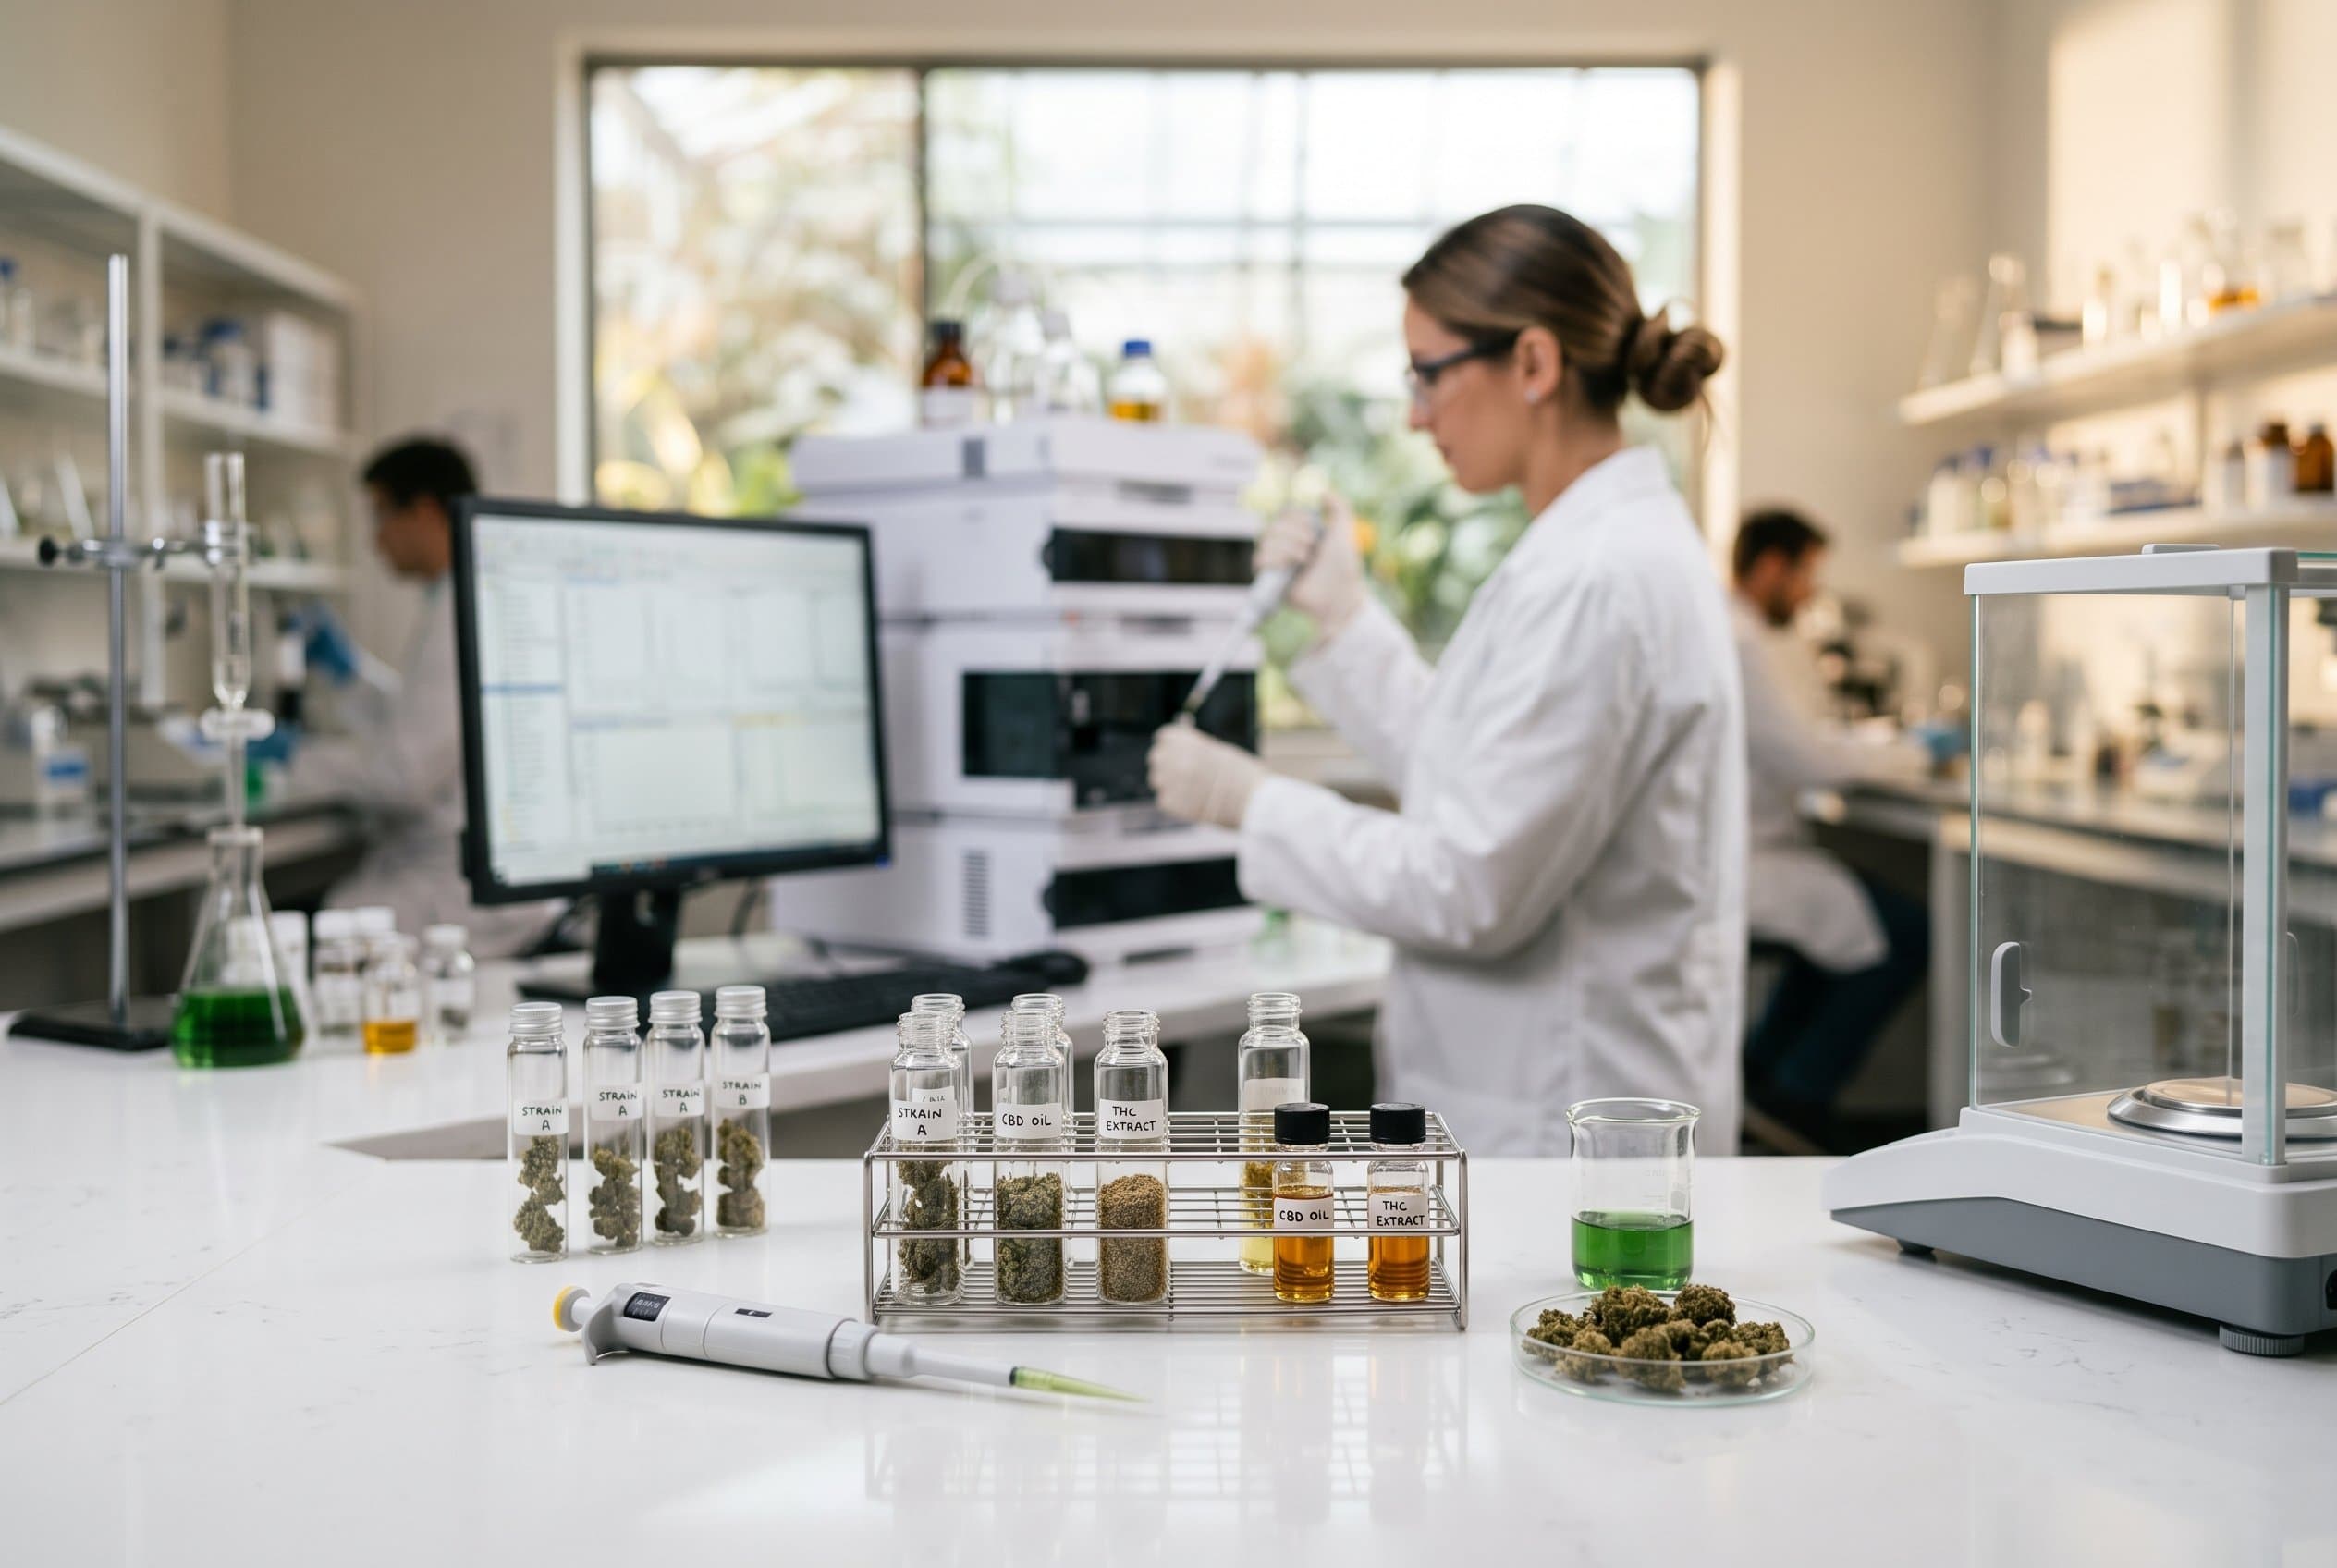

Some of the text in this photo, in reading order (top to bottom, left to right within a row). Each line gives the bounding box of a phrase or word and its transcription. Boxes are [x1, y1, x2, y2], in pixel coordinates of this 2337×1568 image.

[739, 1094, 747, 1105] B
[618, 1105, 628, 1117] A
[679, 1102, 688, 1112] A
[1112, 1106, 1137, 1117] THC
[542, 1120, 550, 1131] A
[1002, 1113, 1024, 1126] CBD
[917, 1124, 927, 1136] A
[1106, 1120, 1156, 1132] EXTRACT
[1382, 1200, 1407, 1211] THC
[1279, 1209, 1303, 1222] CBD
[1377, 1214, 1425, 1227] EXTRACT
